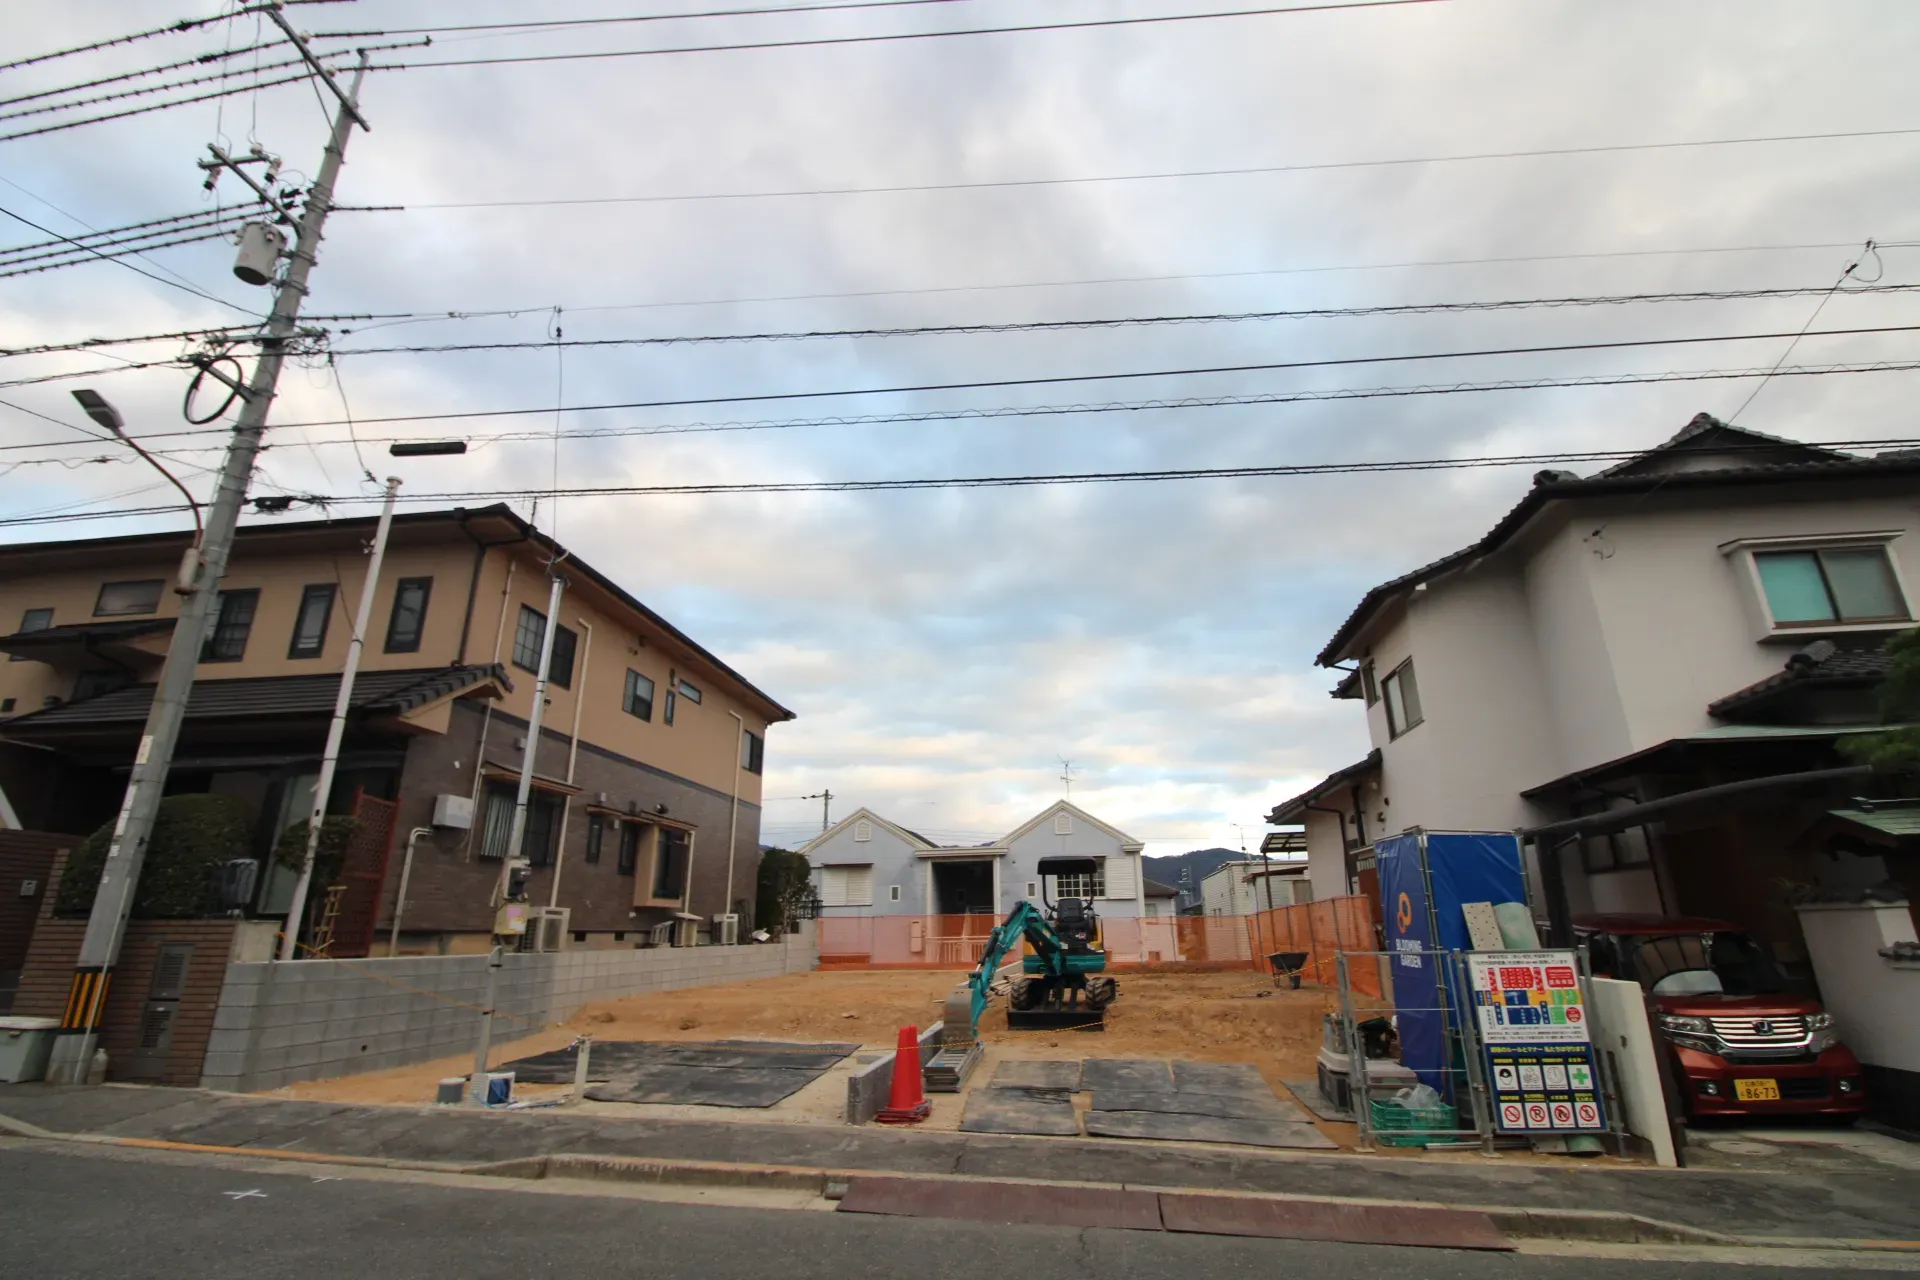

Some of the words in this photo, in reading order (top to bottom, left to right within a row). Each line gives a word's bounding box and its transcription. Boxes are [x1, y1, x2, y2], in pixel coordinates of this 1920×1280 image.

[1396, 938, 1422, 952] BLOOMING
[1401, 954, 1422, 968] GARDEN
[1746, 1087, 1777, 1099] 86-73
